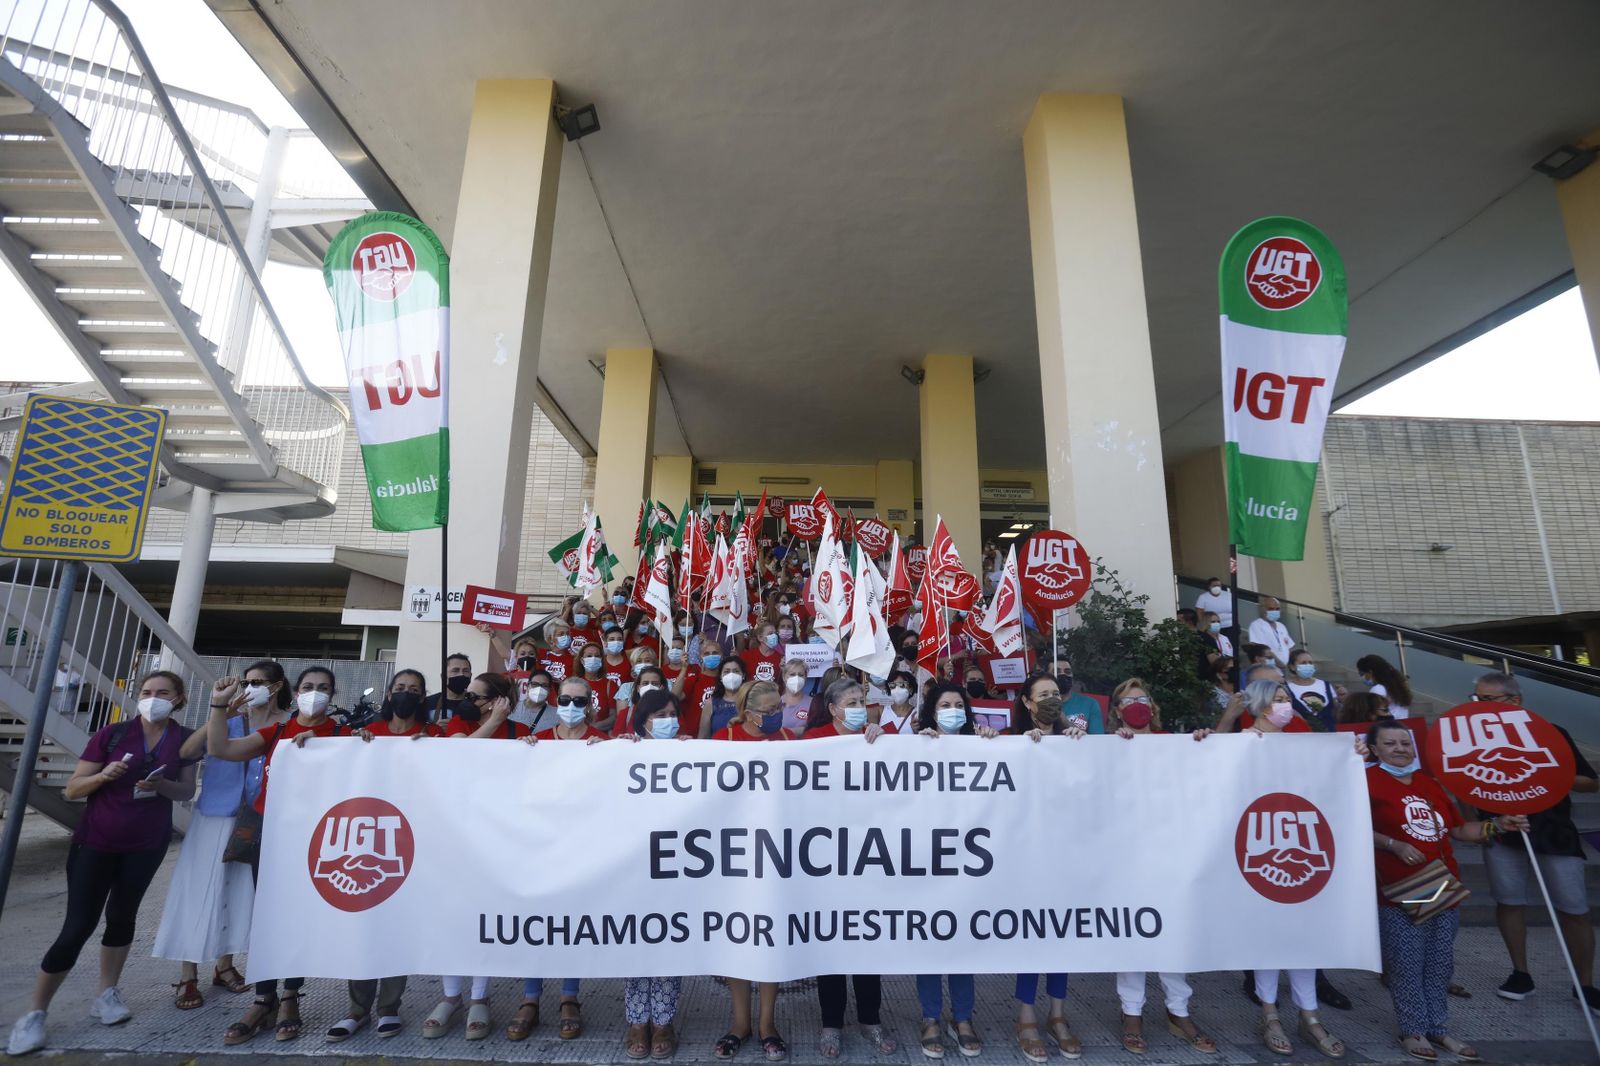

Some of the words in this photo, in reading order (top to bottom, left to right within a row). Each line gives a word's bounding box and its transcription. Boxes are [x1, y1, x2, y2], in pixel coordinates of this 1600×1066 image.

[1254, 247, 1312, 280] UGT
[15, 507, 40, 518] NO
[46, 509, 129, 524] BLOQUEAR
[789, 504, 816, 520] UGT
[23, 535, 111, 550] BOMBEROS
[49, 523, 92, 535] SOLO
[861, 520, 890, 541] UGT
[1026, 538, 1078, 568] UGT
[758, 666, 772, 674] UGT
[1439, 710, 1540, 756] UGT
[627, 760, 770, 795] SECTOR
[783, 759, 830, 791] DE
[844, 760, 1016, 792] LIMPIEZA
[319, 816, 402, 860] UGT
[1245, 811, 1321, 853] UGT
[649, 826, 994, 880] ESENCIALES
[479, 911, 690, 945] LUCHAMOS
[703, 911, 775, 947] POR
[787, 909, 957, 946] NUESTRO
[969, 906, 1163, 941] CONVENIO
